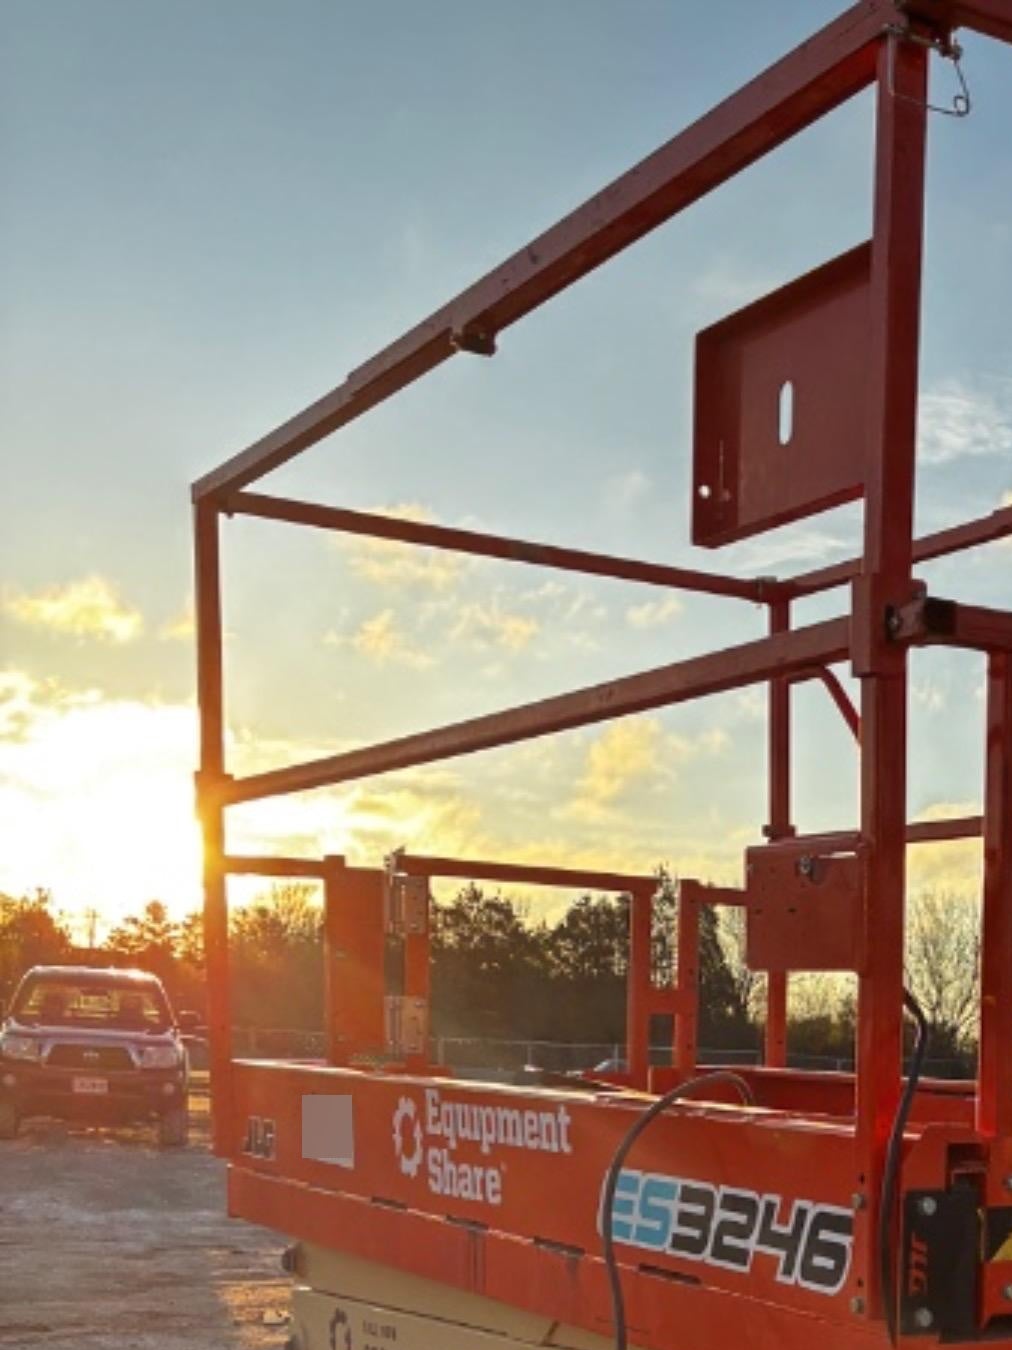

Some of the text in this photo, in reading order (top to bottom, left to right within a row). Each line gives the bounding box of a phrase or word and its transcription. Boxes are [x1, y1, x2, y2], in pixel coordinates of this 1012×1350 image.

[425, 1087, 573, 1155] Equipment
[427, 1145, 503, 1204] Share
[598, 1168, 857, 1297] ES3246
